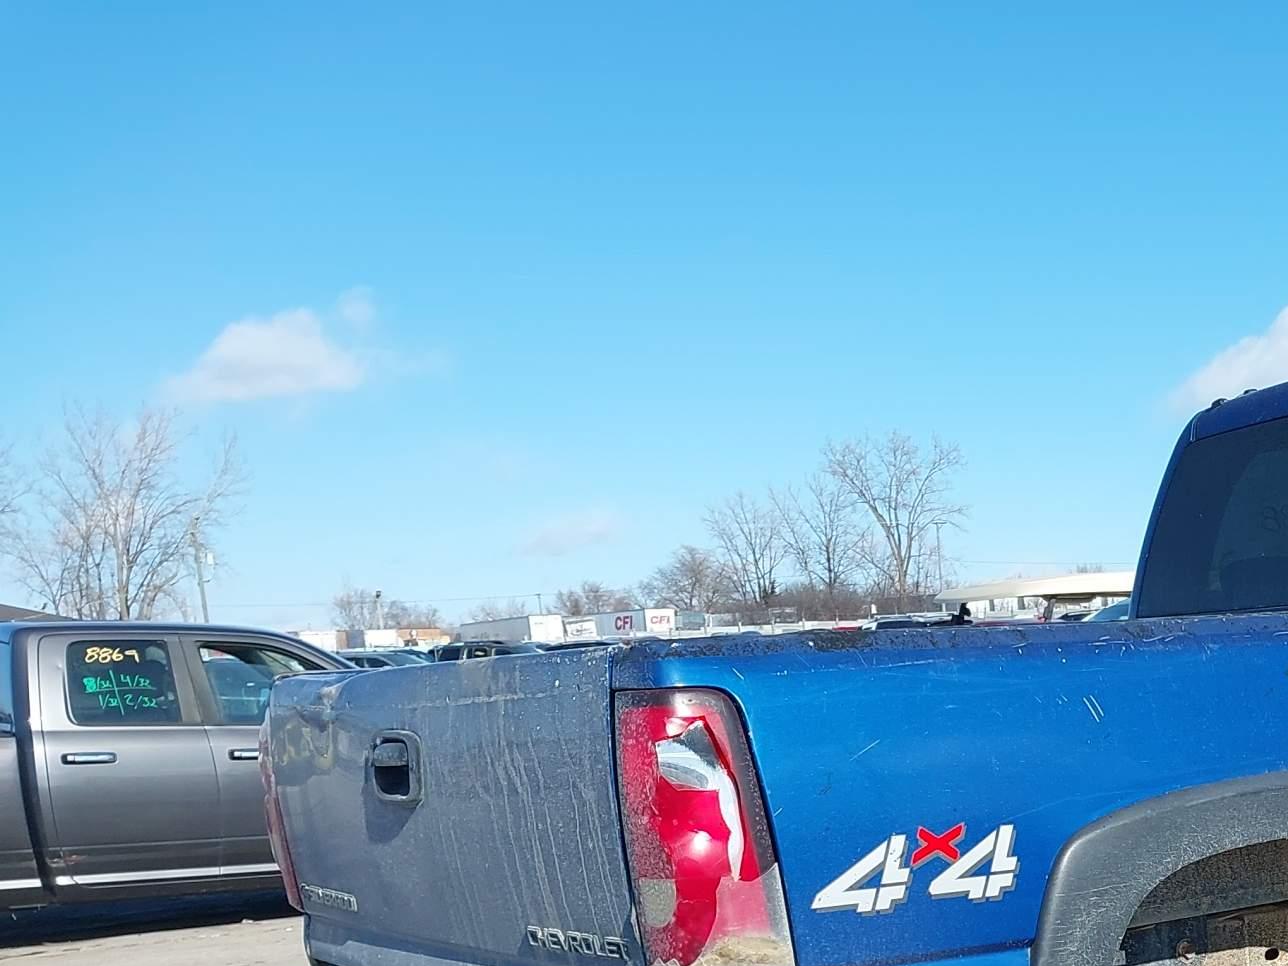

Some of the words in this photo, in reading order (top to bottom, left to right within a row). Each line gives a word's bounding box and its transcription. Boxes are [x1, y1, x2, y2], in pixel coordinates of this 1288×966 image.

[614, 615, 633, 631] CFI
[649, 615, 671, 625] CFI
[84, 646, 139, 663] 8869
[526, 925, 630, 961] CHEVROLET
